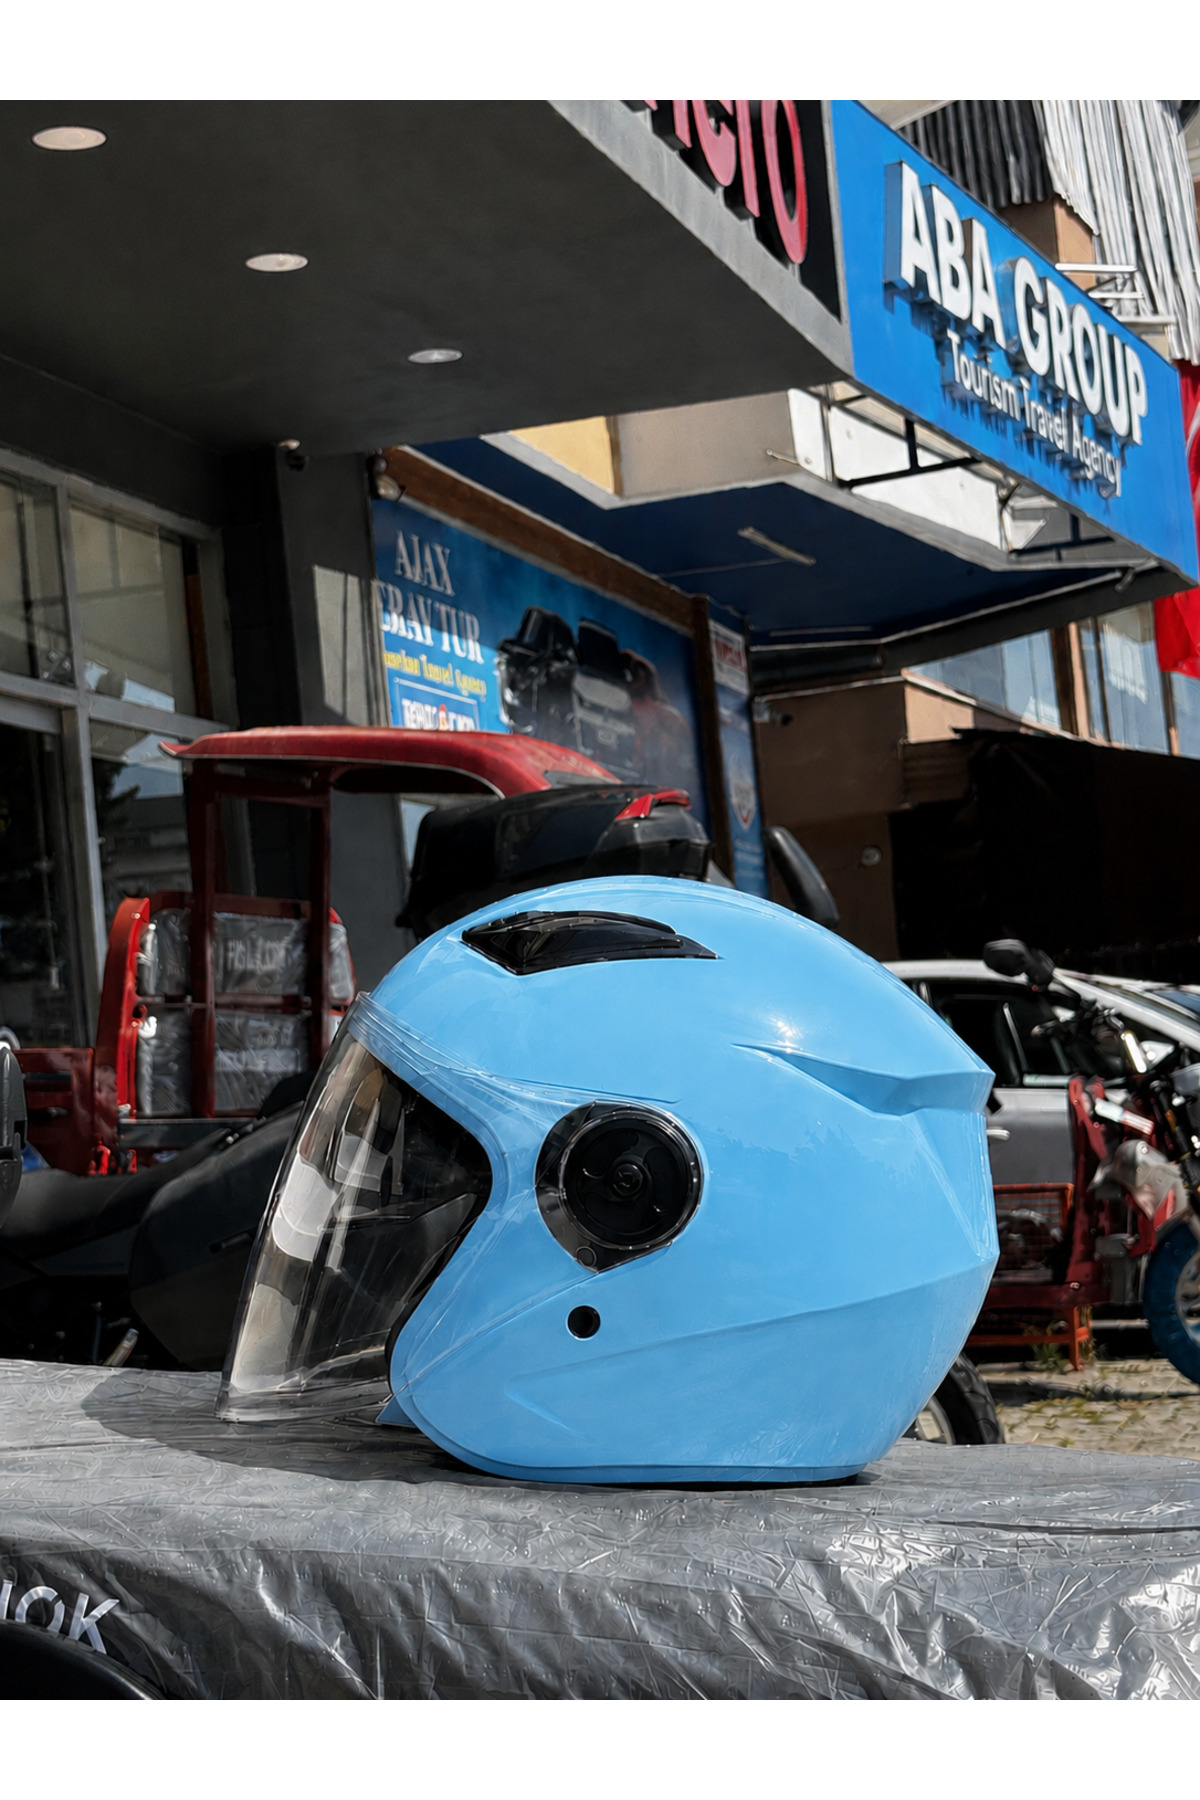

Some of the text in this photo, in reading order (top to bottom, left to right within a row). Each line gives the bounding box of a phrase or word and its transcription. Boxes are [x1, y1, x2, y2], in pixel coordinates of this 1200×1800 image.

[900, 160, 1149, 446] ABA GROUP
[946, 327, 1122, 498] Tourism Travel Agency
[394, 529, 456, 598] AJAX
[433, 600, 485, 665] TUR
